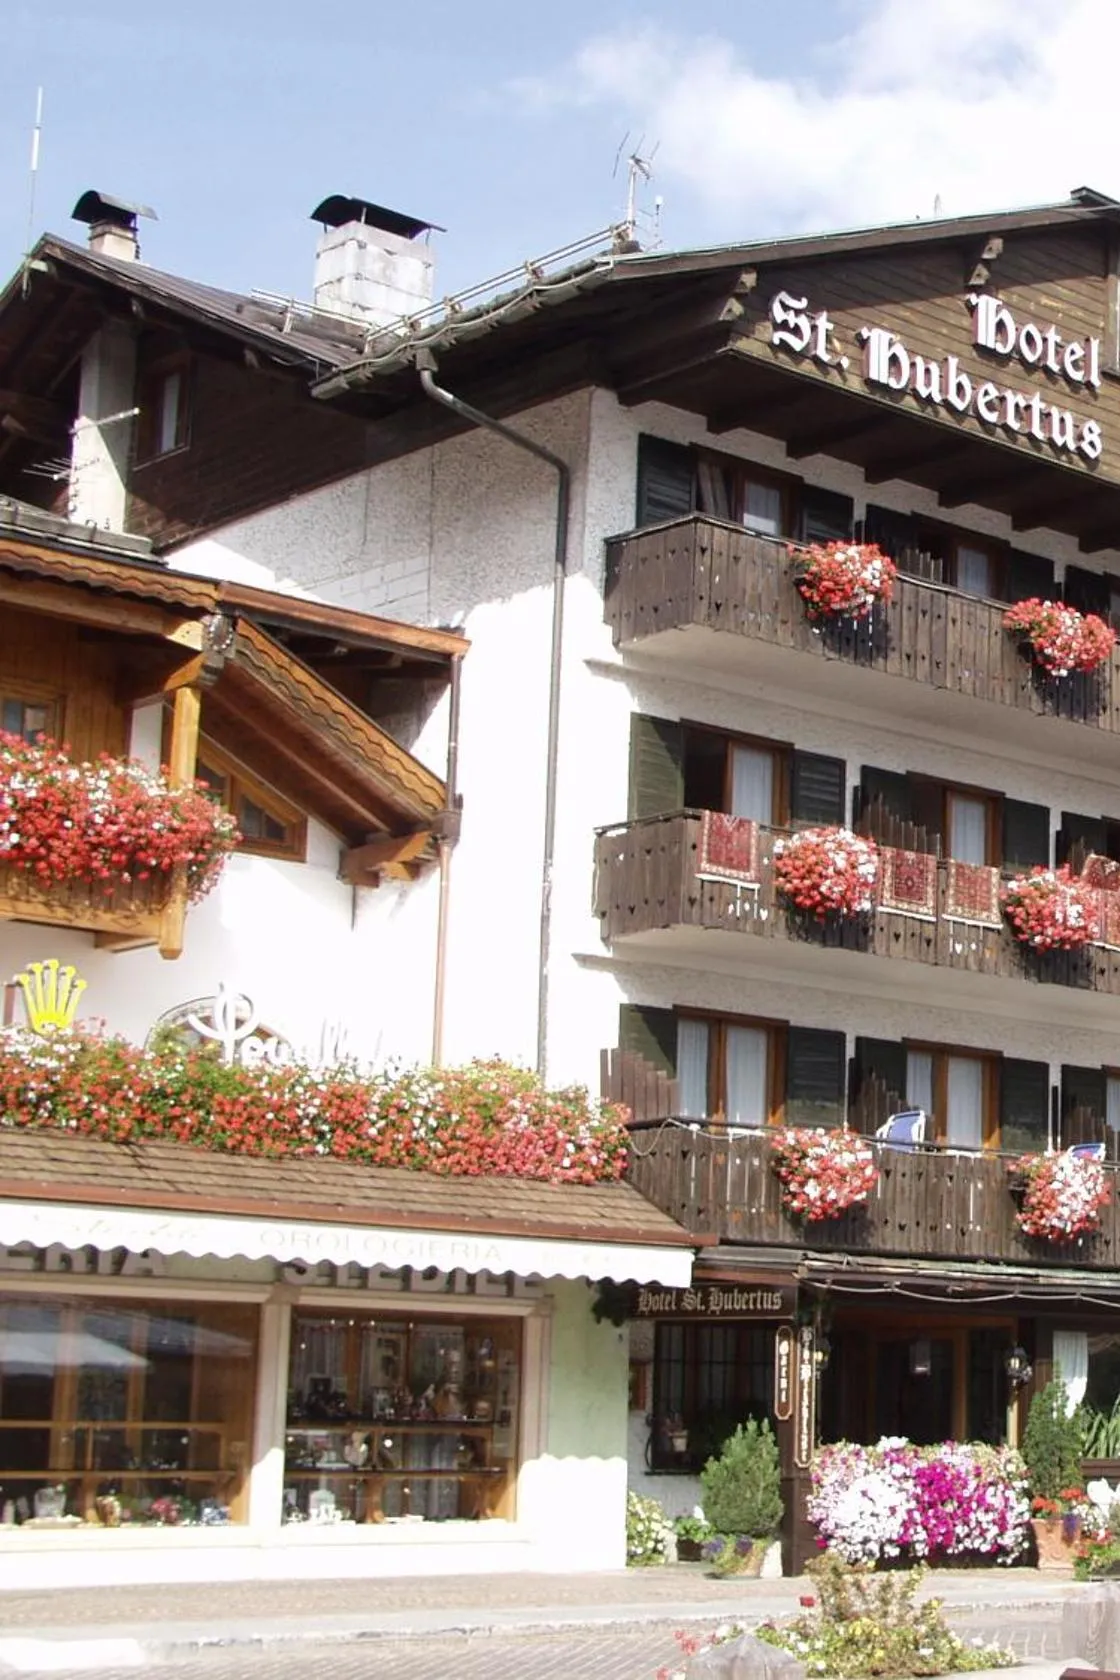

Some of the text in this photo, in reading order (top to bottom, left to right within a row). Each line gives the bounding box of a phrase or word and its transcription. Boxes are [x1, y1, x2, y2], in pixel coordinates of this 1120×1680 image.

[771, 290, 1103, 460] St. Hubertus
[967, 292, 1101, 388] Hotel
[638, 1286, 783, 1315] Hotel St. Hubertus
